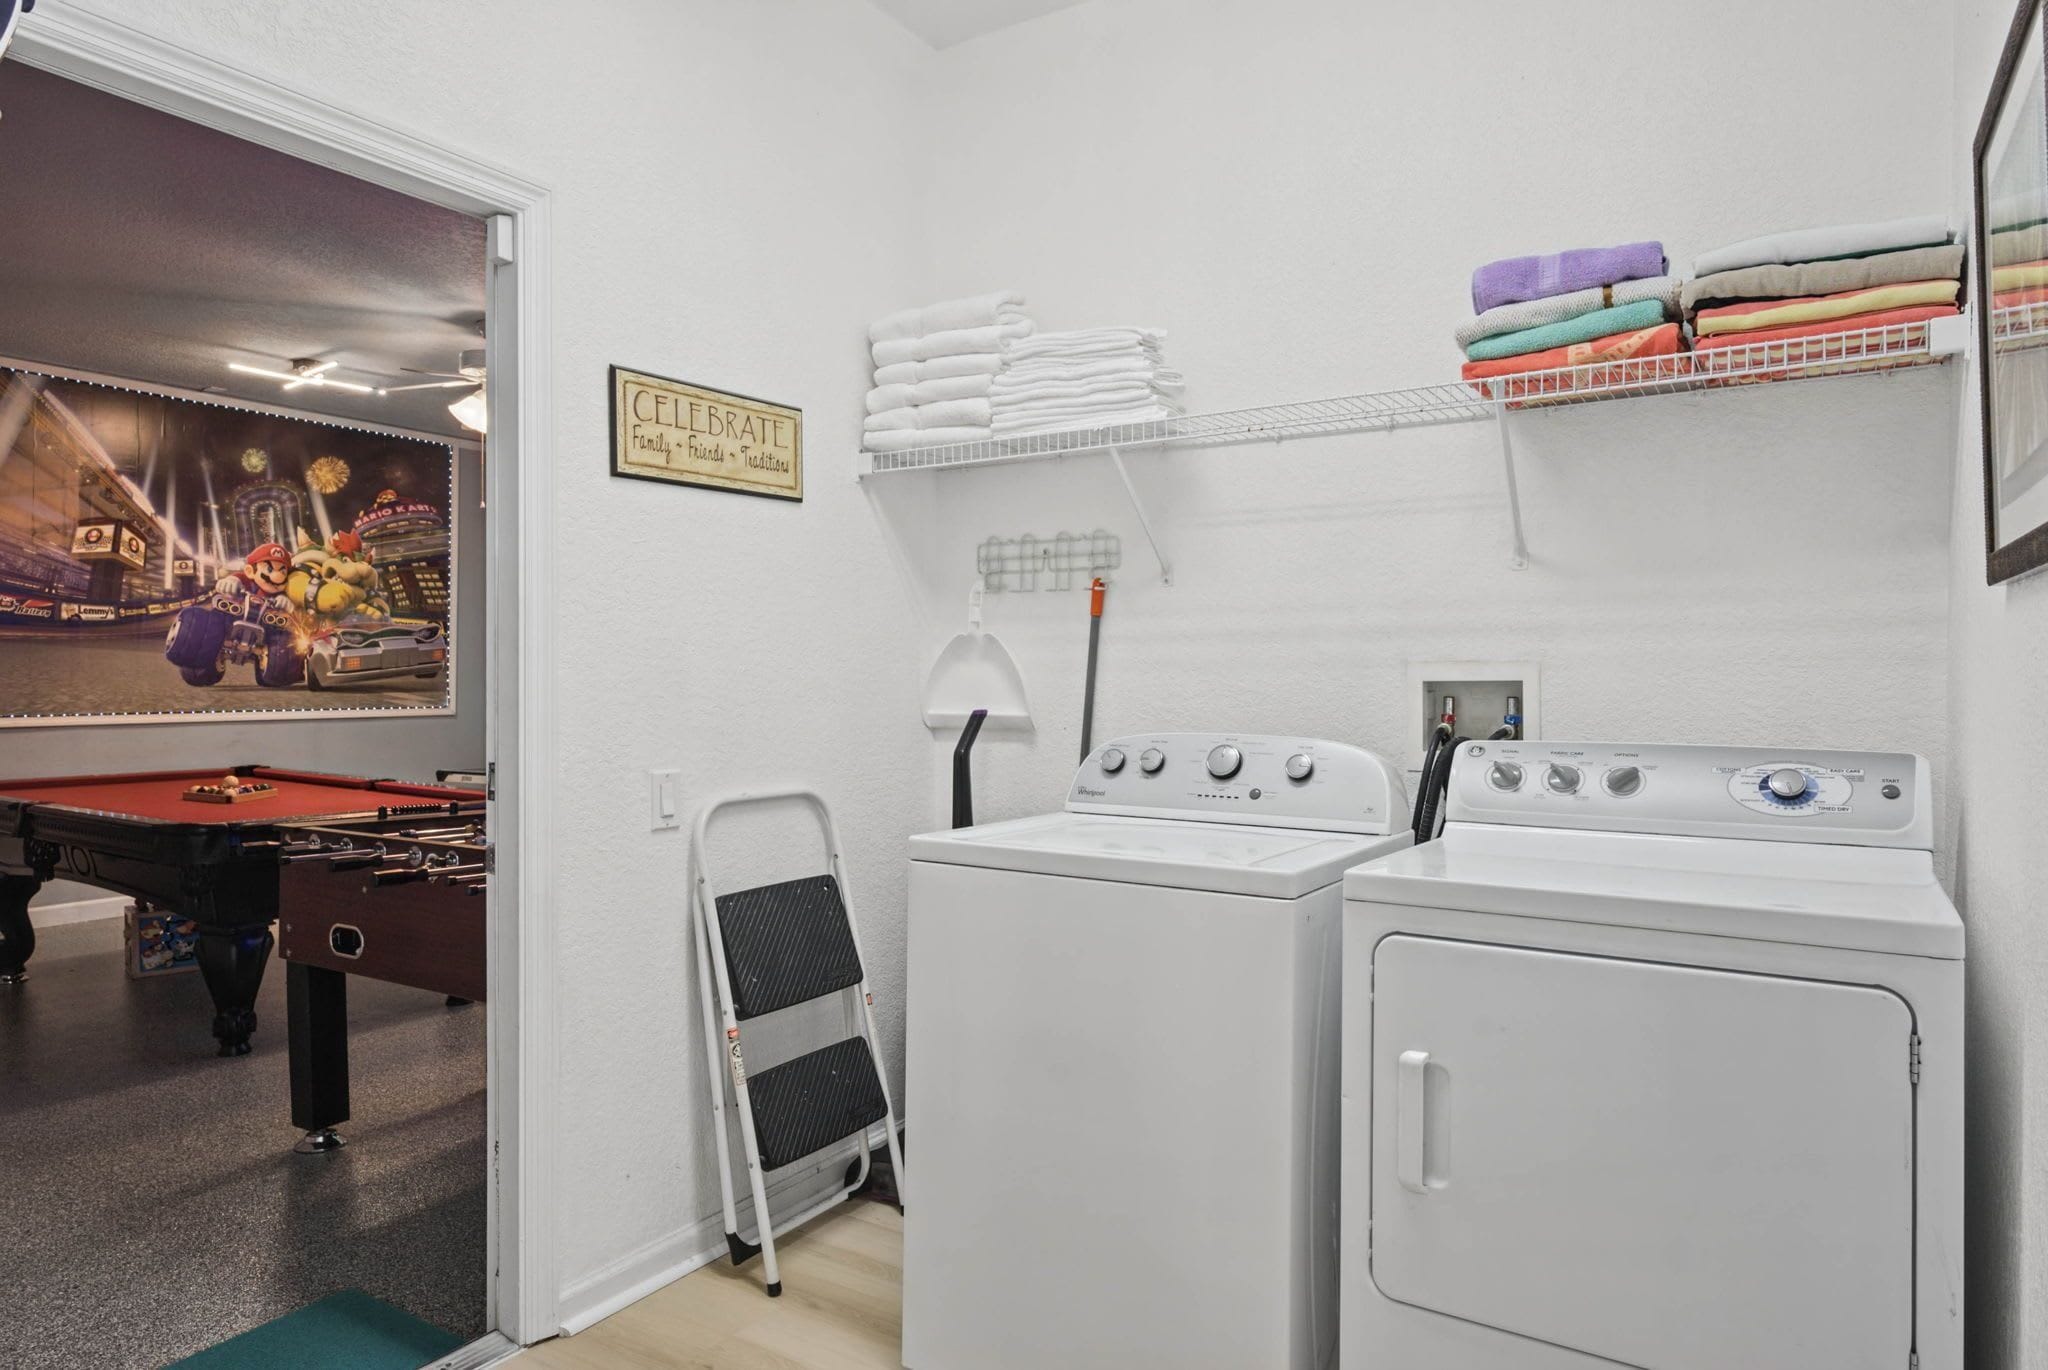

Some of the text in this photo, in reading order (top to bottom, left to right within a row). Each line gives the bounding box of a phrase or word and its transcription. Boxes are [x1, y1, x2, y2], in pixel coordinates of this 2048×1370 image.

[633, 390, 788, 449] CELEBRATE
[632, 424, 672, 464] Family
[688, 435, 725, 463] Friends
[741, 445, 790, 474] Traditions
[354, 508, 392, 527] MARIO
[78, 605, 114, 619] Lemmy's
[1077, 787, 1106, 797] Whirlpool
